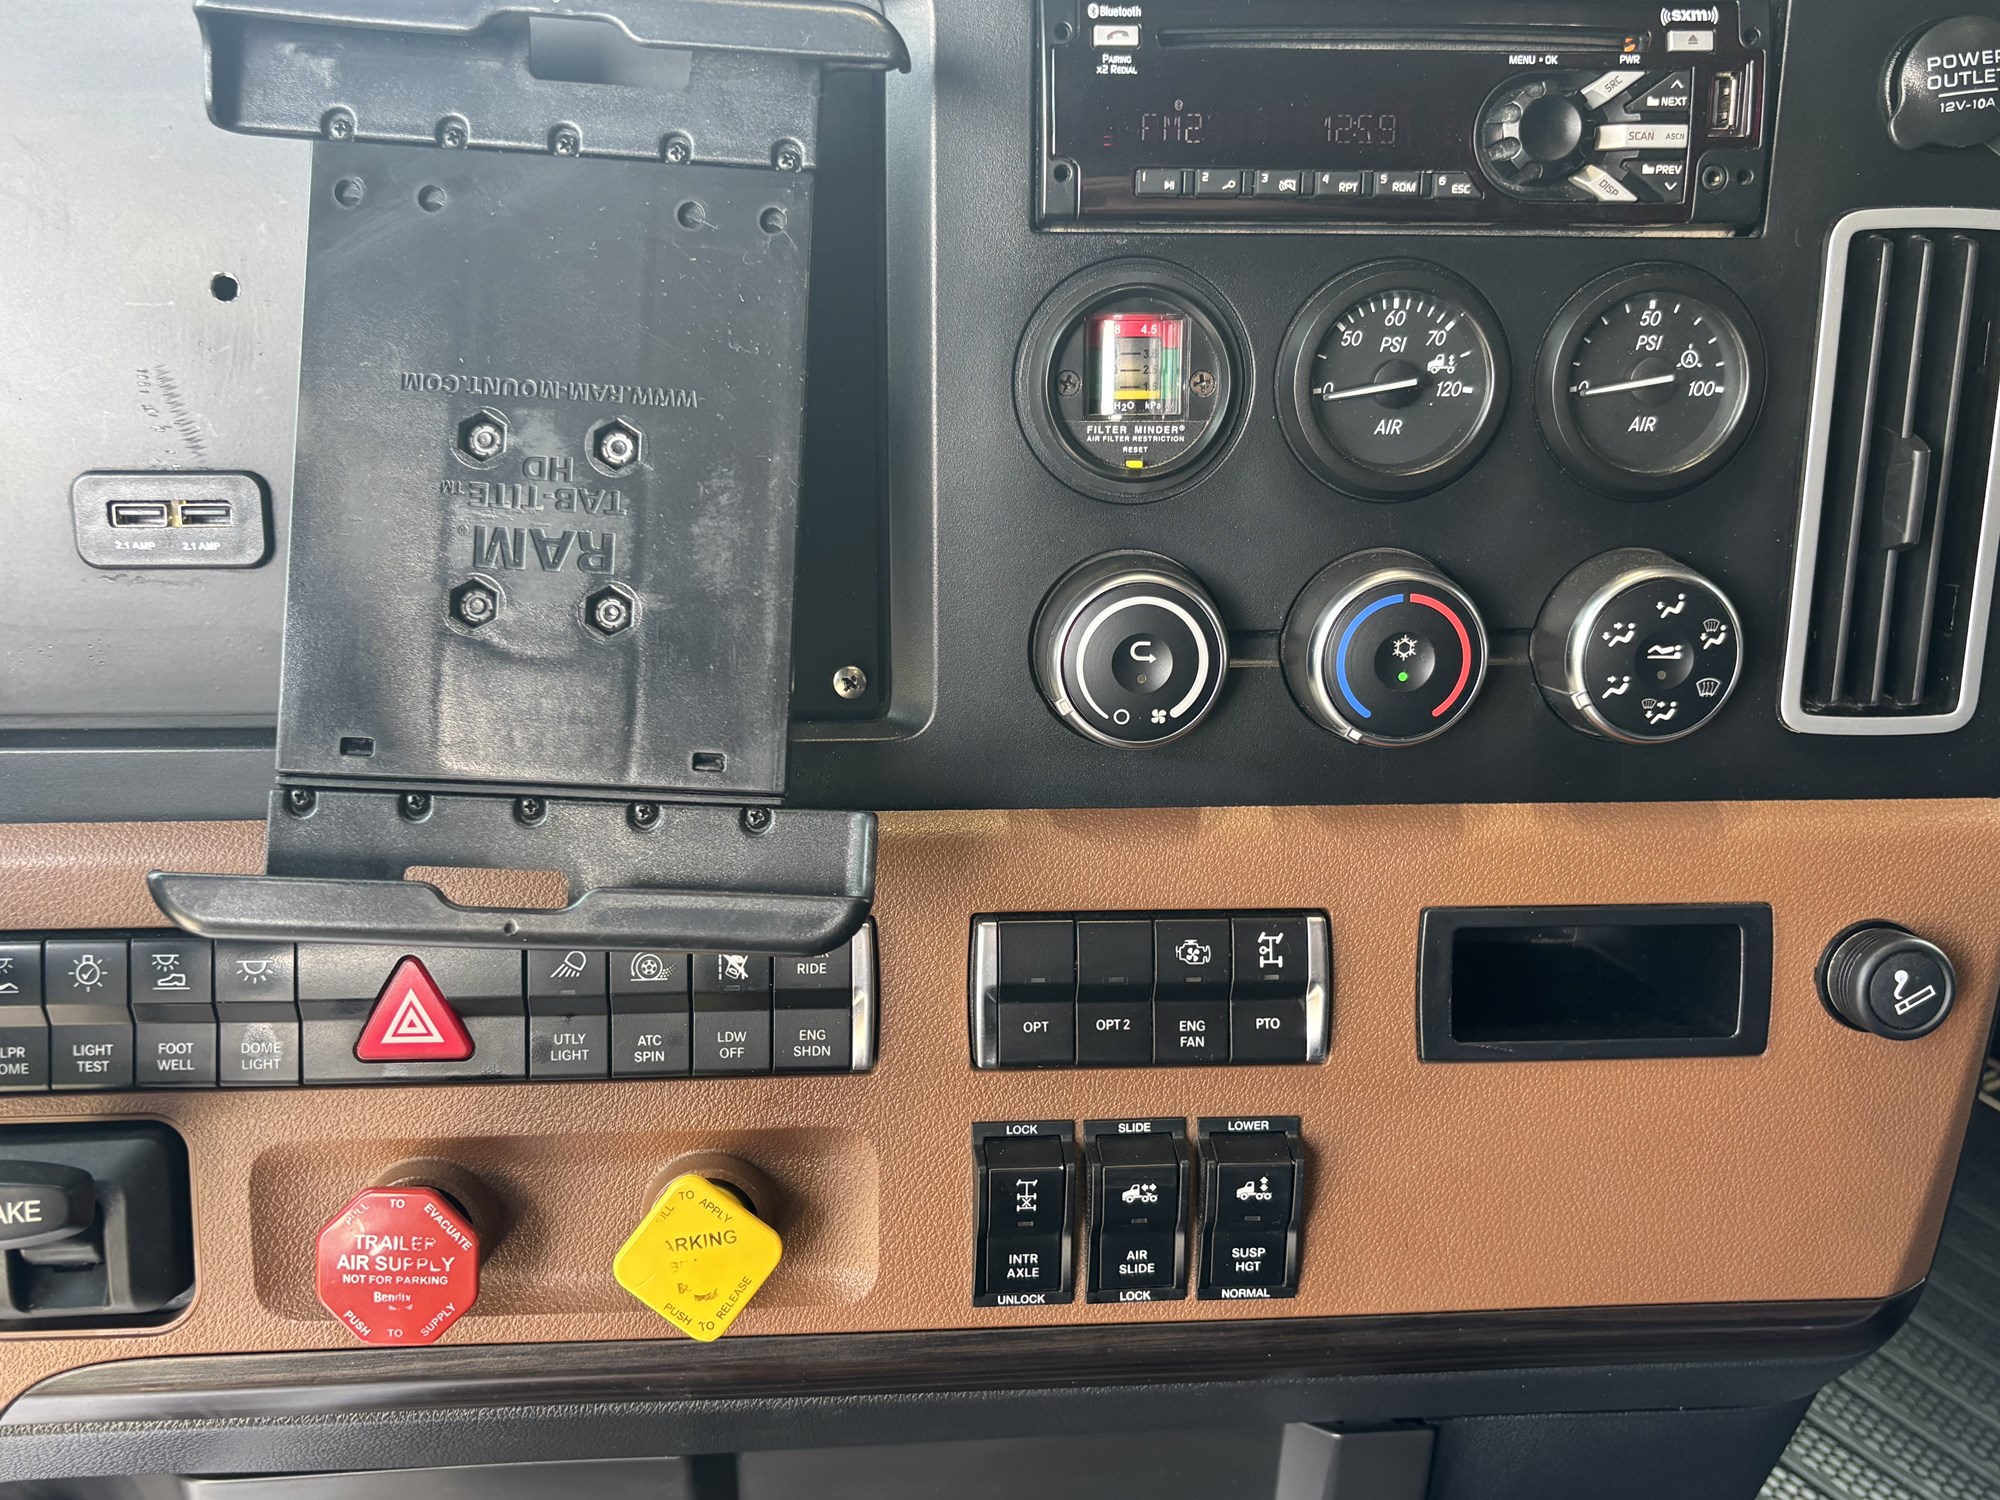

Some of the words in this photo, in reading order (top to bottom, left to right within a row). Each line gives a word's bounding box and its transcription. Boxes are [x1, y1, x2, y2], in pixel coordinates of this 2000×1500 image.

[1100, 5, 1142, 17] Bluetooth
[1671, 9, 1708, 22] sxm
[1508, 55, 1536, 65] MENU
[1544, 55, 1559, 65] OK
[1619, 55, 1641, 65] PWR
[1604, 75, 1623, 93] SRC
[1661, 96, 1687, 107] NEXT
[1940, 97, 1996, 113] 12V-10A
[1141, 113, 1203, 144] FM2
[1628, 130, 1655, 141] SCAN
[1665, 132, 1685, 141] ASCN
[1655, 164, 1682, 176] PREV
[1202, 173, 1209, 182] 2
[1261, 173, 1269, 183] 3
[1322, 174, 1330, 184] 4
[1380, 174, 1388, 184] 5
[1438, 176, 1446, 186] 6
[1338, 182, 1358, 193] RPT
[1392, 182, 1416, 193] RDM
[1451, 184, 1471, 195] ESC
[1598, 178, 1620, 198] DISP
[1384, 310, 1406, 327] 60
[1639, 310, 1662, 327] 50
[1141, 324, 1157, 335] 4.5
[1341, 330, 1363, 347] 50
[1379, 336, 1407, 353] PSI
[1425, 330, 1447, 346] 70
[1635, 334, 1663, 351] PSI
[401, 372, 698, 408] WWW.RAM-MOUNT.COM
[1436, 381, 1462, 397] 120
[1688, 381, 1715, 397] 100
[1087, 426, 1127, 434] FILTER
[1373, 419, 1403, 435] AIR
[1628, 416, 1657, 432] AIR
[522, 456, 574, 482] HD
[114, 541, 130, 550] 2.1
[132, 542, 155, 550] AMP
[182, 542, 197, 550] 2.1
[198, 542, 221, 551] AMP
[797, 962, 827, 975] RIDE
[1023, 1021, 1049, 1033] OPT
[1096, 1019, 1121, 1031] OPT
[1122, 1018, 1131, 1031] 2
[1179, 1020, 1206, 1033] ENG
[1255, 1017, 1281, 1030] PTO
[554, 1032, 587, 1045] UTLY
[637, 1034, 662, 1047] ATC
[717, 1030, 747, 1043] LDW
[799, 1029, 826, 1042] ENG
[1180, 1036, 1205, 1048] FAN
[73, 1044, 114, 1057] LIGHT
[158, 1042, 194, 1055] FOOT
[240, 1041, 282, 1054] DOME
[719, 1046, 745, 1059] OFF
[793, 1044, 831, 1057] SHDN
[550, 1048, 589, 1061] LIGHT
[633, 1050, 665, 1063] SPIN
[76, 1060, 110, 1073] TEST
[157, 1058, 195, 1071] WELL
[241, 1057, 282, 1071] LIGHT
[1006, 1124, 1038, 1135] LOCK
[1118, 1122, 1151, 1134] SLIDE
[1227, 1120, 1269, 1131] LOWER
[678, 1190, 695, 1201] TO
[699, 1198, 733, 1223] APPLY
[390, 1199, 405, 1209] TO
[424, 1203, 473, 1251] EVACUATE
[354, 1234, 437, 1252] TRAILER
[1008, 1253, 1038, 1265] INTR
[1126, 1249, 1148, 1262] AIR
[1231, 1247, 1266, 1259] SUSP
[336, 1254, 370, 1271] AIR
[375, 1256, 455, 1272] SUPPLY
[1119, 1263, 1155, 1275] SLIDE
[1235, 1260, 1261, 1272] HGT
[342, 1274, 367, 1284] NOT
[369, 1275, 392, 1285] FOR
[395, 1275, 448, 1285] PARKING
[1006, 1267, 1039, 1279] AXLE
[997, 1294, 1045, 1305] UNLOCK
[1119, 1290, 1151, 1301] LOCK
[1221, 1287, 1270, 1299] NORMAL
[663, 1302, 693, 1326] PUSH
[698, 1321, 715, 1332] TO
[716, 1275, 753, 1320] RELEASE
[343, 1310, 372, 1337] PUSH
[388, 1328, 403, 1338] TO
[420, 1302, 456, 1337] SUPPLY
